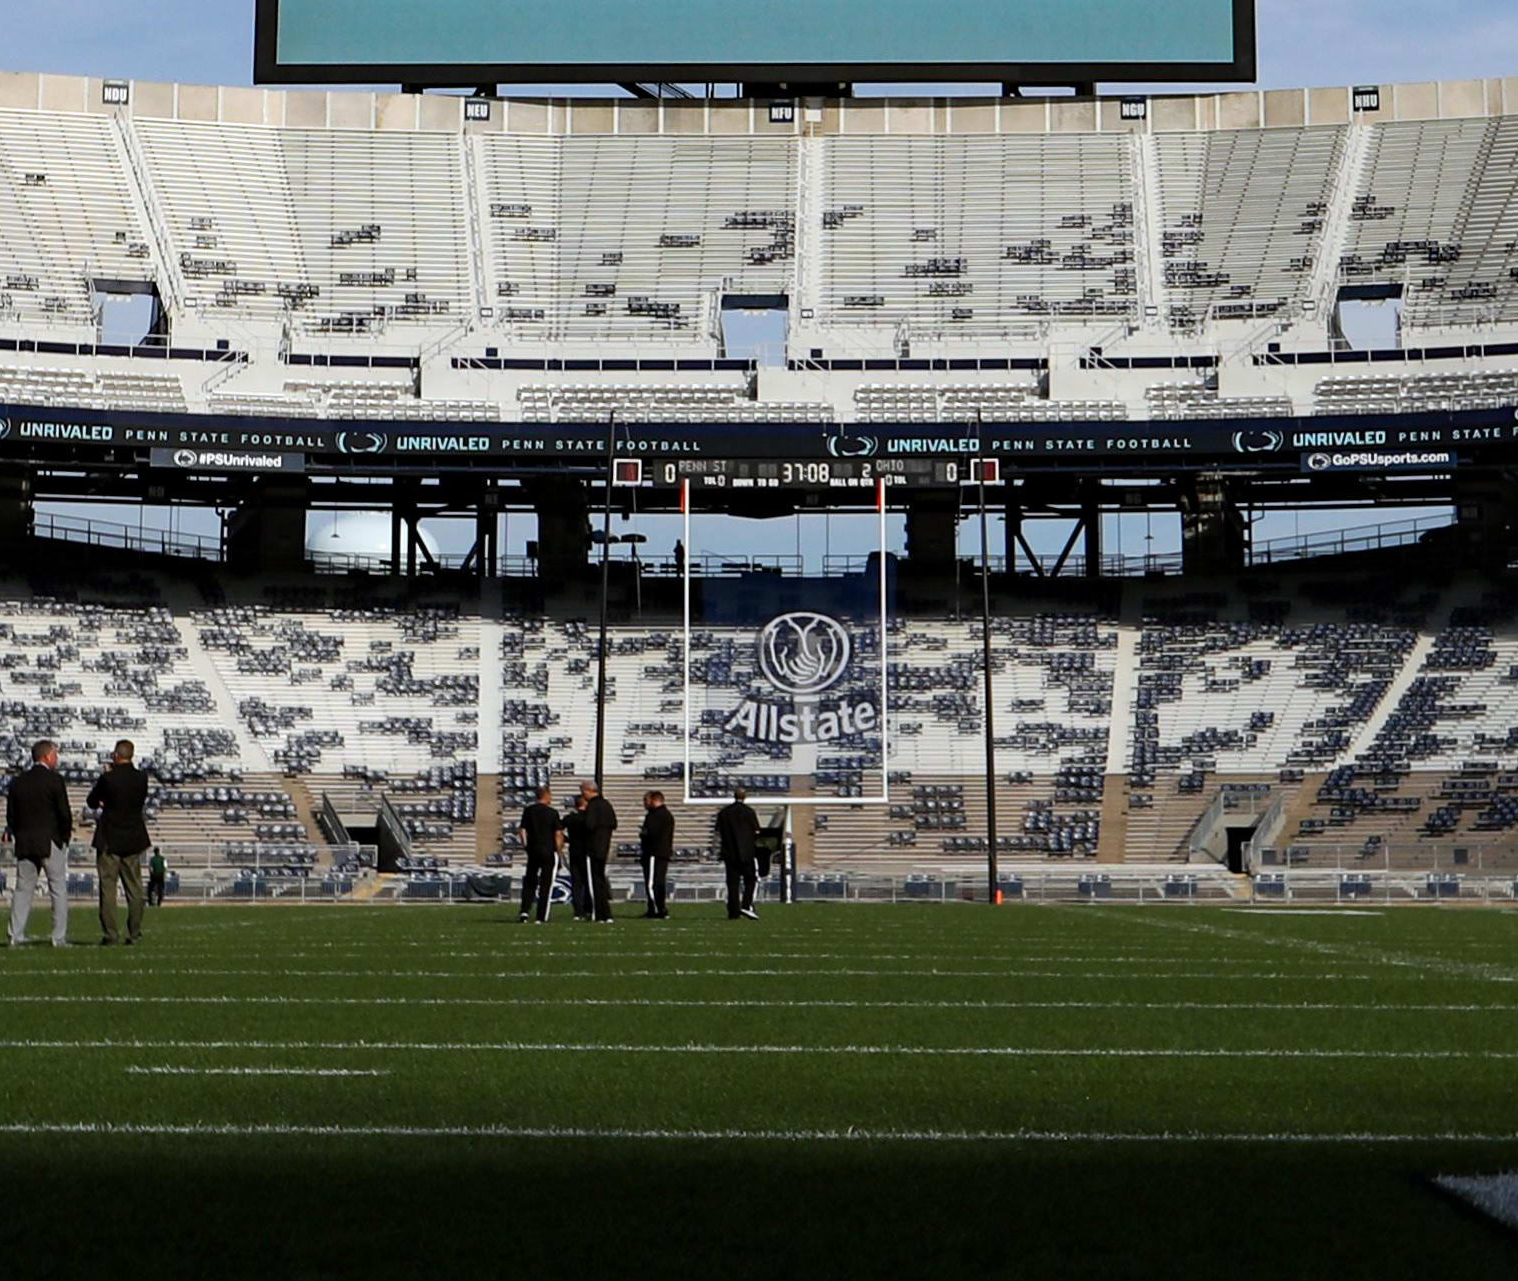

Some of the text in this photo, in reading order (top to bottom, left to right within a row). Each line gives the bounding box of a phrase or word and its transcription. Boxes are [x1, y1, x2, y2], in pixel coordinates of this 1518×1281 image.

[104, 86, 128, 102] NDU
[20, 422, 325, 447] UNRIVALED PENN STATE FOOTBALL
[1293, 431, 1386, 447] UNRIVALED
[1398, 430, 1441, 442] PENN
[1452, 427, 1501, 440] STATE
[396, 436, 701, 451] UNRIVALED PENN STATE FOOTBALL
[887, 438, 1191, 452] UNRIVALED PENN STATE FOOTBALL
[199, 452, 282, 468] #PSUnrivaled
[679, 460, 727, 472] PENN ST
[876, 459, 904, 472] OHIO
[1333, 452, 1449, 467] GoPSUsports.com
[665, 463, 676, 483] 0
[783, 463, 829, 483] 37:08
[946, 462, 958, 482] 0
[724, 699, 876, 743] Allstate
